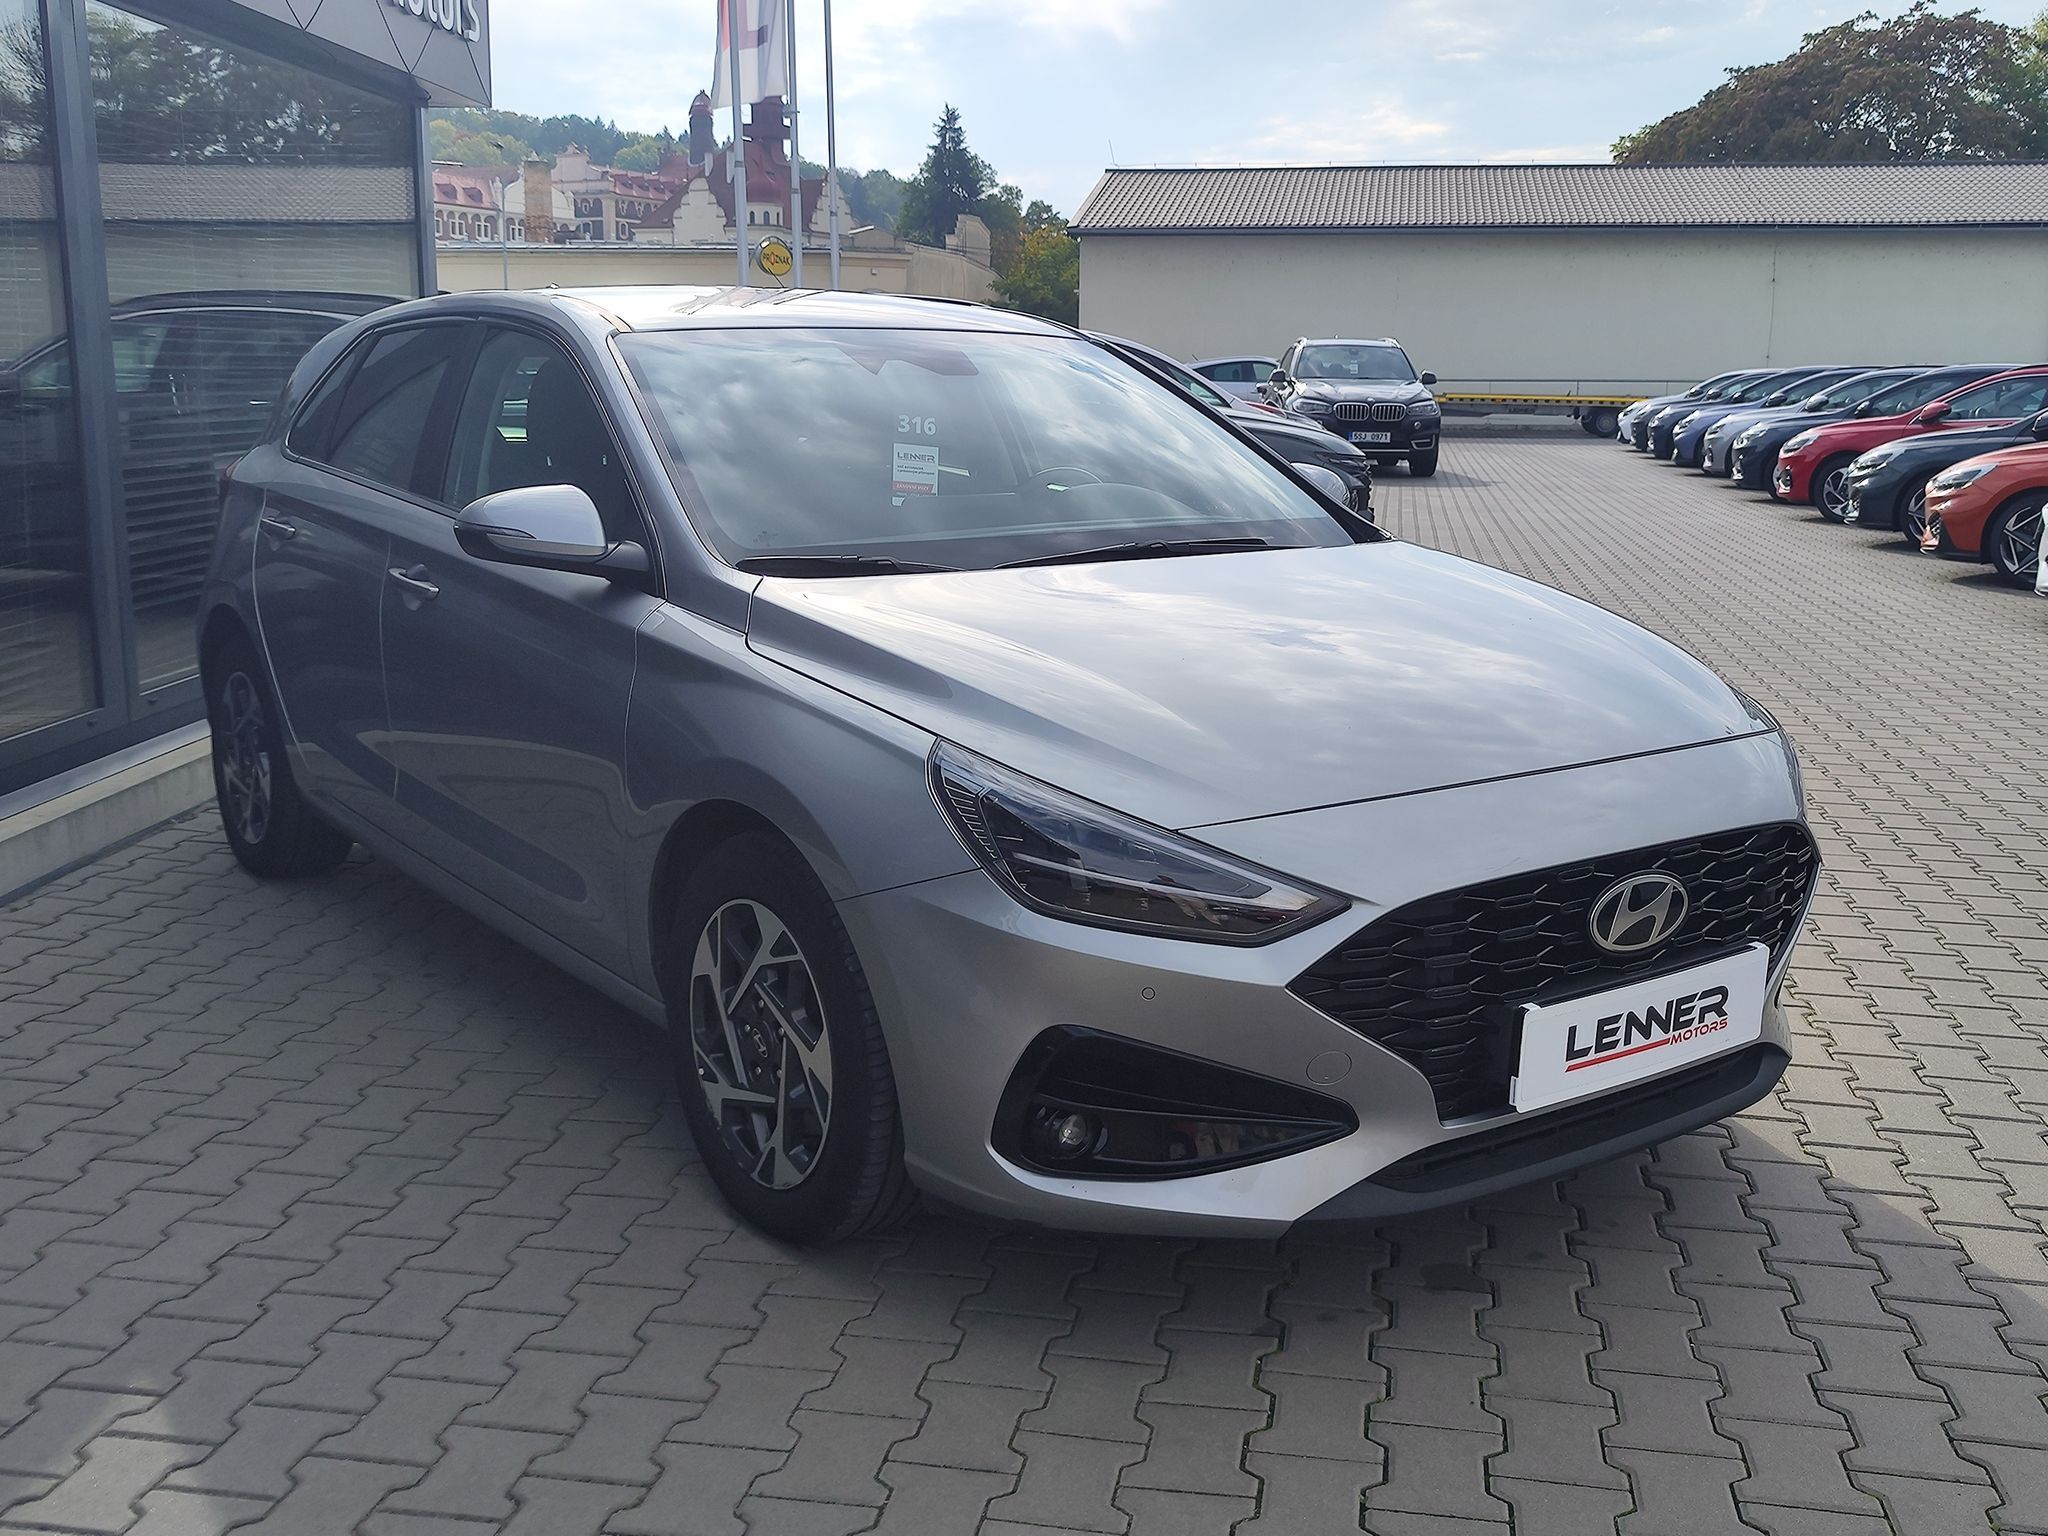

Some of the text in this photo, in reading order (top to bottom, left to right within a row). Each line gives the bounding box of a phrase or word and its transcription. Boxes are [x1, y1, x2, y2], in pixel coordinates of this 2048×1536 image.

[897, 414, 937, 436] 316
[1354, 432, 1389, 441] 5SJ 0971
[1565, 985, 1729, 1062] LENNER
[1670, 1017, 1728, 1046] MOTORS
